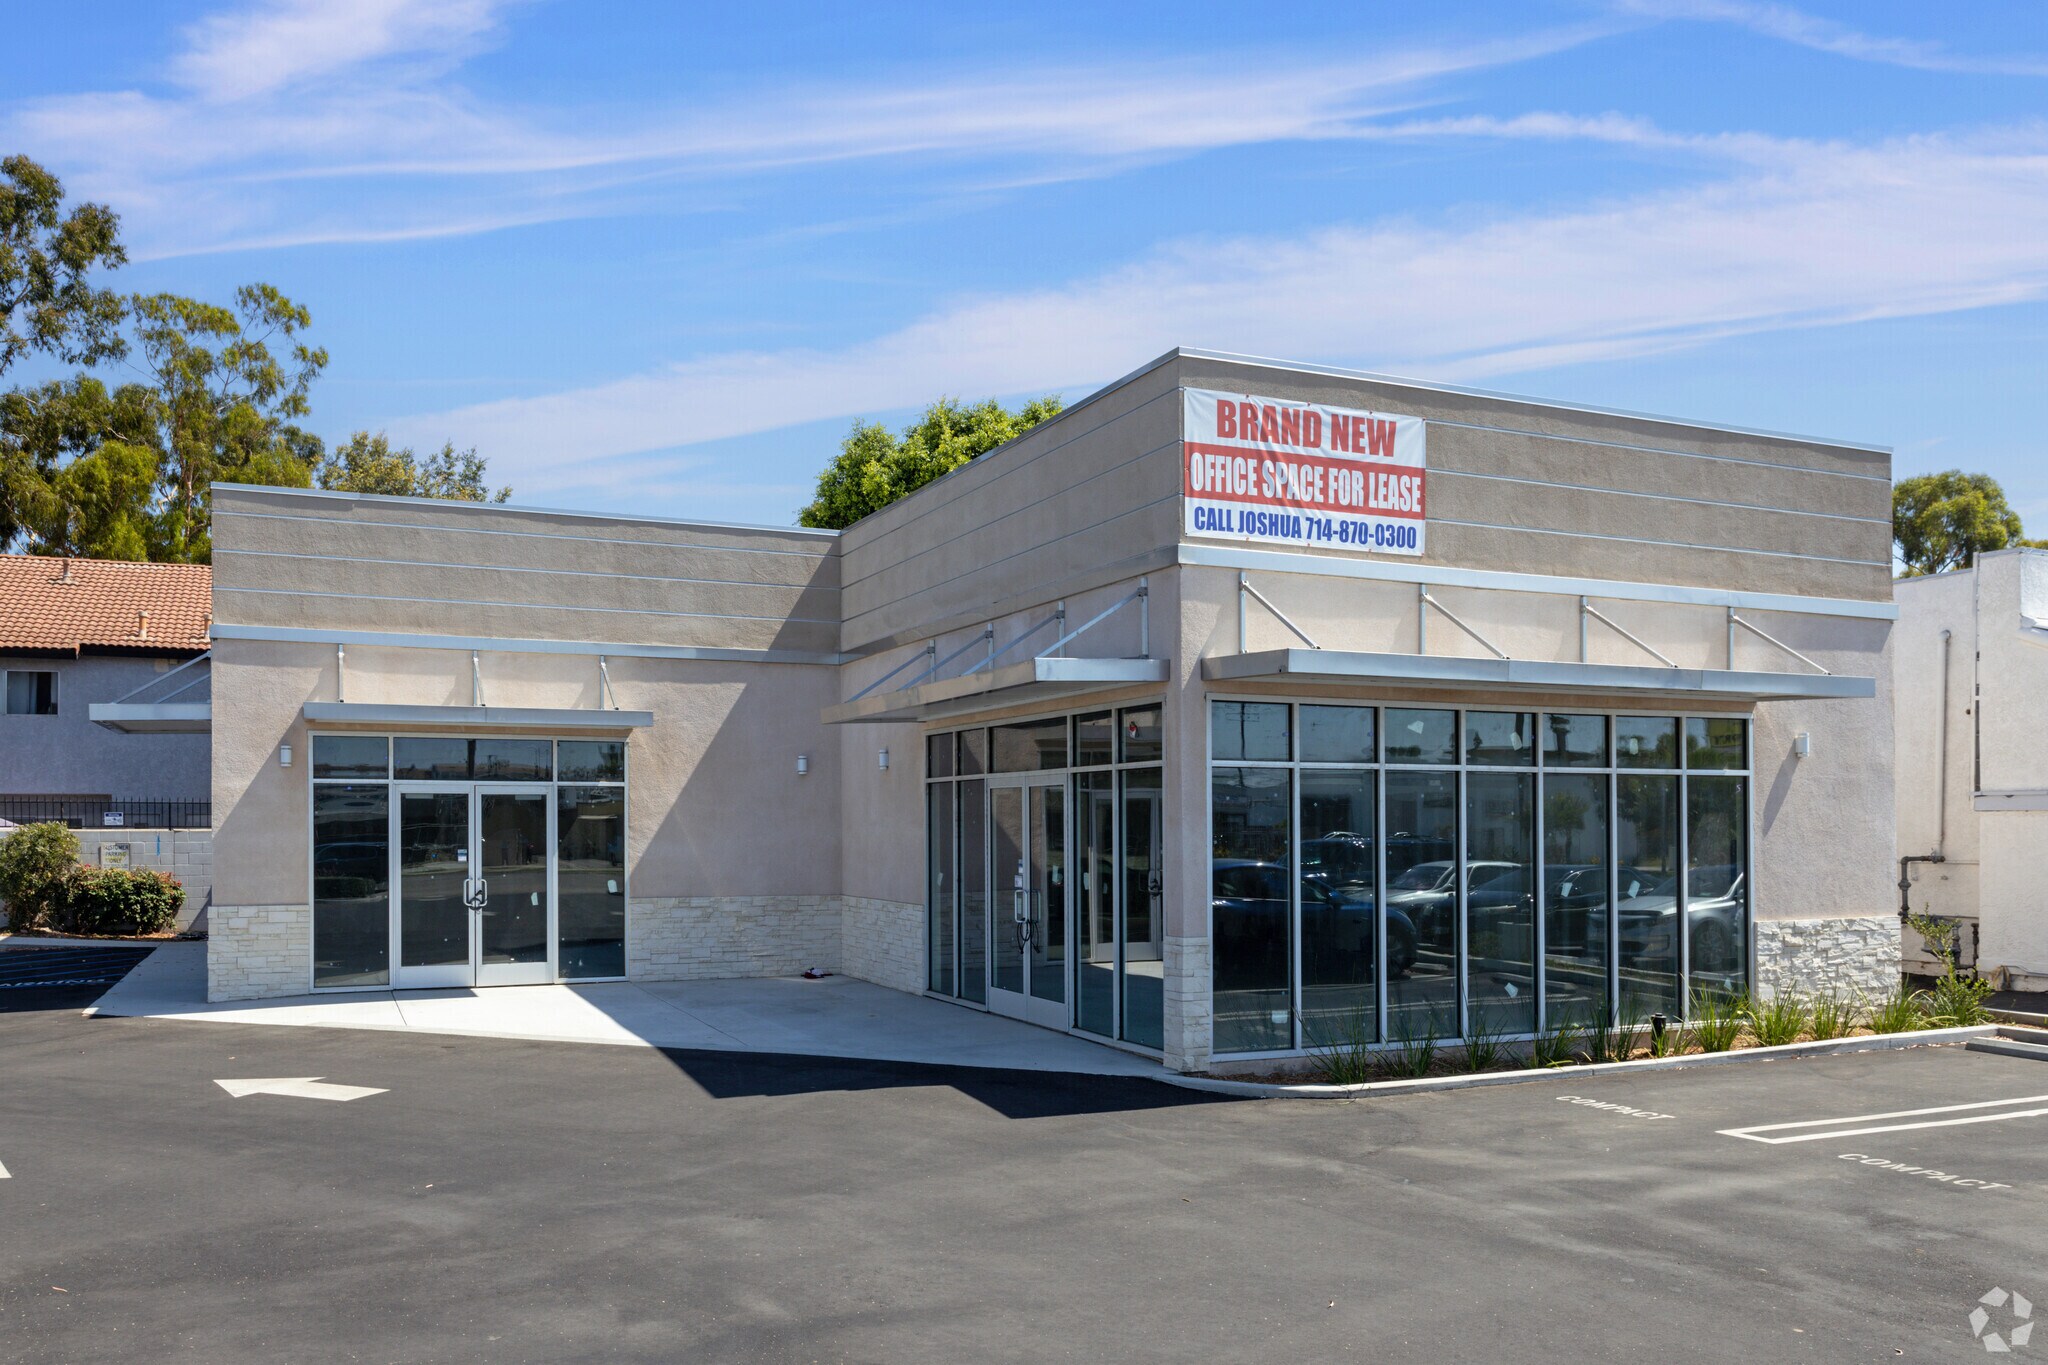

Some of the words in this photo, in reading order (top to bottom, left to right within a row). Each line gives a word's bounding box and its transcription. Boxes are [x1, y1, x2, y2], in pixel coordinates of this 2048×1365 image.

[1216, 399, 1322, 449] BRAND
[1330, 414, 1397, 457] NEW
[1190, 452, 1258, 496] OFFICE
[1261, 460, 1324, 504] SPACE
[1328, 468, 1364, 507] FOR
[1368, 472, 1421, 513] LEASE
[1194, 506, 1234, 533] CALL
[1237, 510, 1302, 539] JOSHUA
[1305, 516, 1417, 549] 714-870-0300
[1556, 1095, 1677, 1120] COMPACT
[1837, 1153, 2012, 1190] COMPACT
